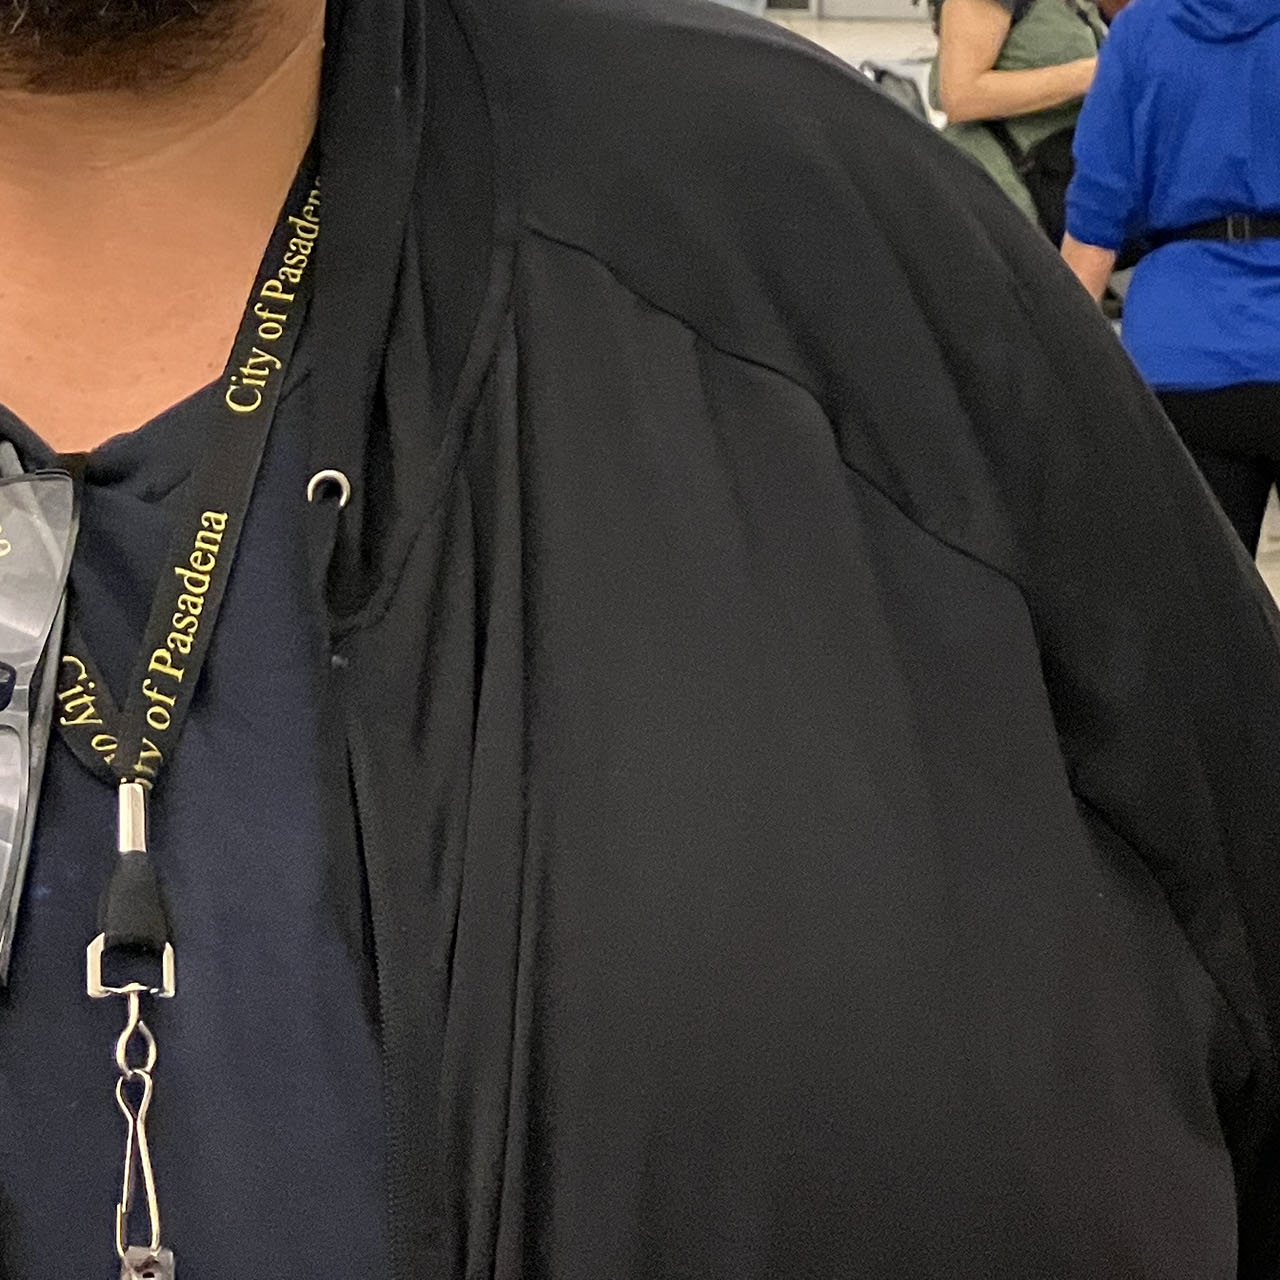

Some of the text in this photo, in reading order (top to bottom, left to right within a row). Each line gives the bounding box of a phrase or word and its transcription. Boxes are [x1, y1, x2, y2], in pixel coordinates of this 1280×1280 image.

[225, 347, 282, 413] City
[254, 303, 287, 340] of
[148, 510, 228, 683] Pasadena
[142, 678, 176, 731] of
